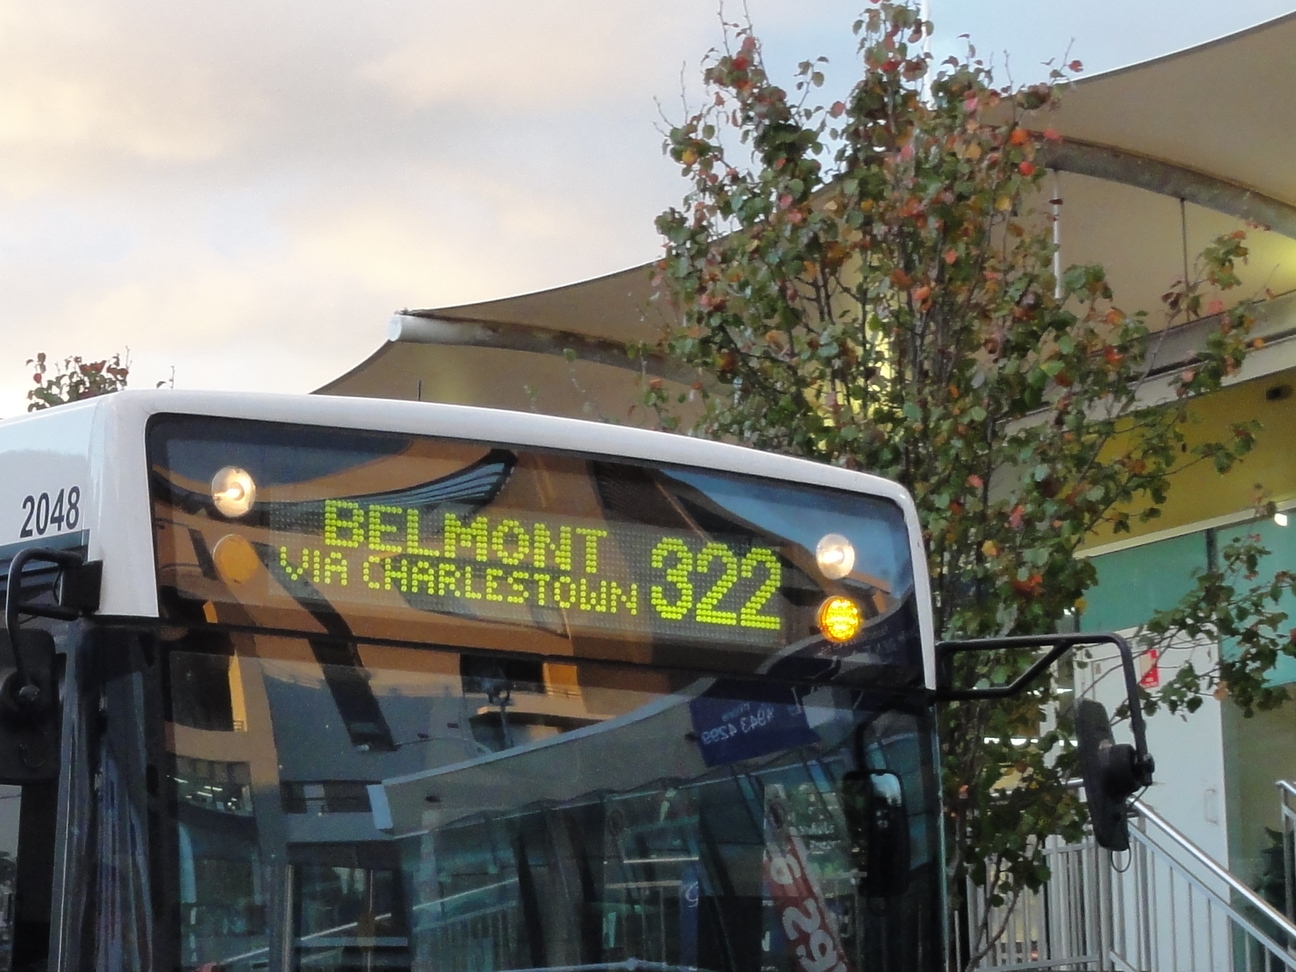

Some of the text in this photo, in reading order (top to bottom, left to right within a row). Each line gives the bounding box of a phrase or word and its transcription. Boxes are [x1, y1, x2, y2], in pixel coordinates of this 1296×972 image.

[19, 485, 81, 539] 2048
[324, 499, 607, 574] BELMONT
[279, 545, 638, 616] VIA CHARLESTOWN
[650, 537, 782, 630] 322
